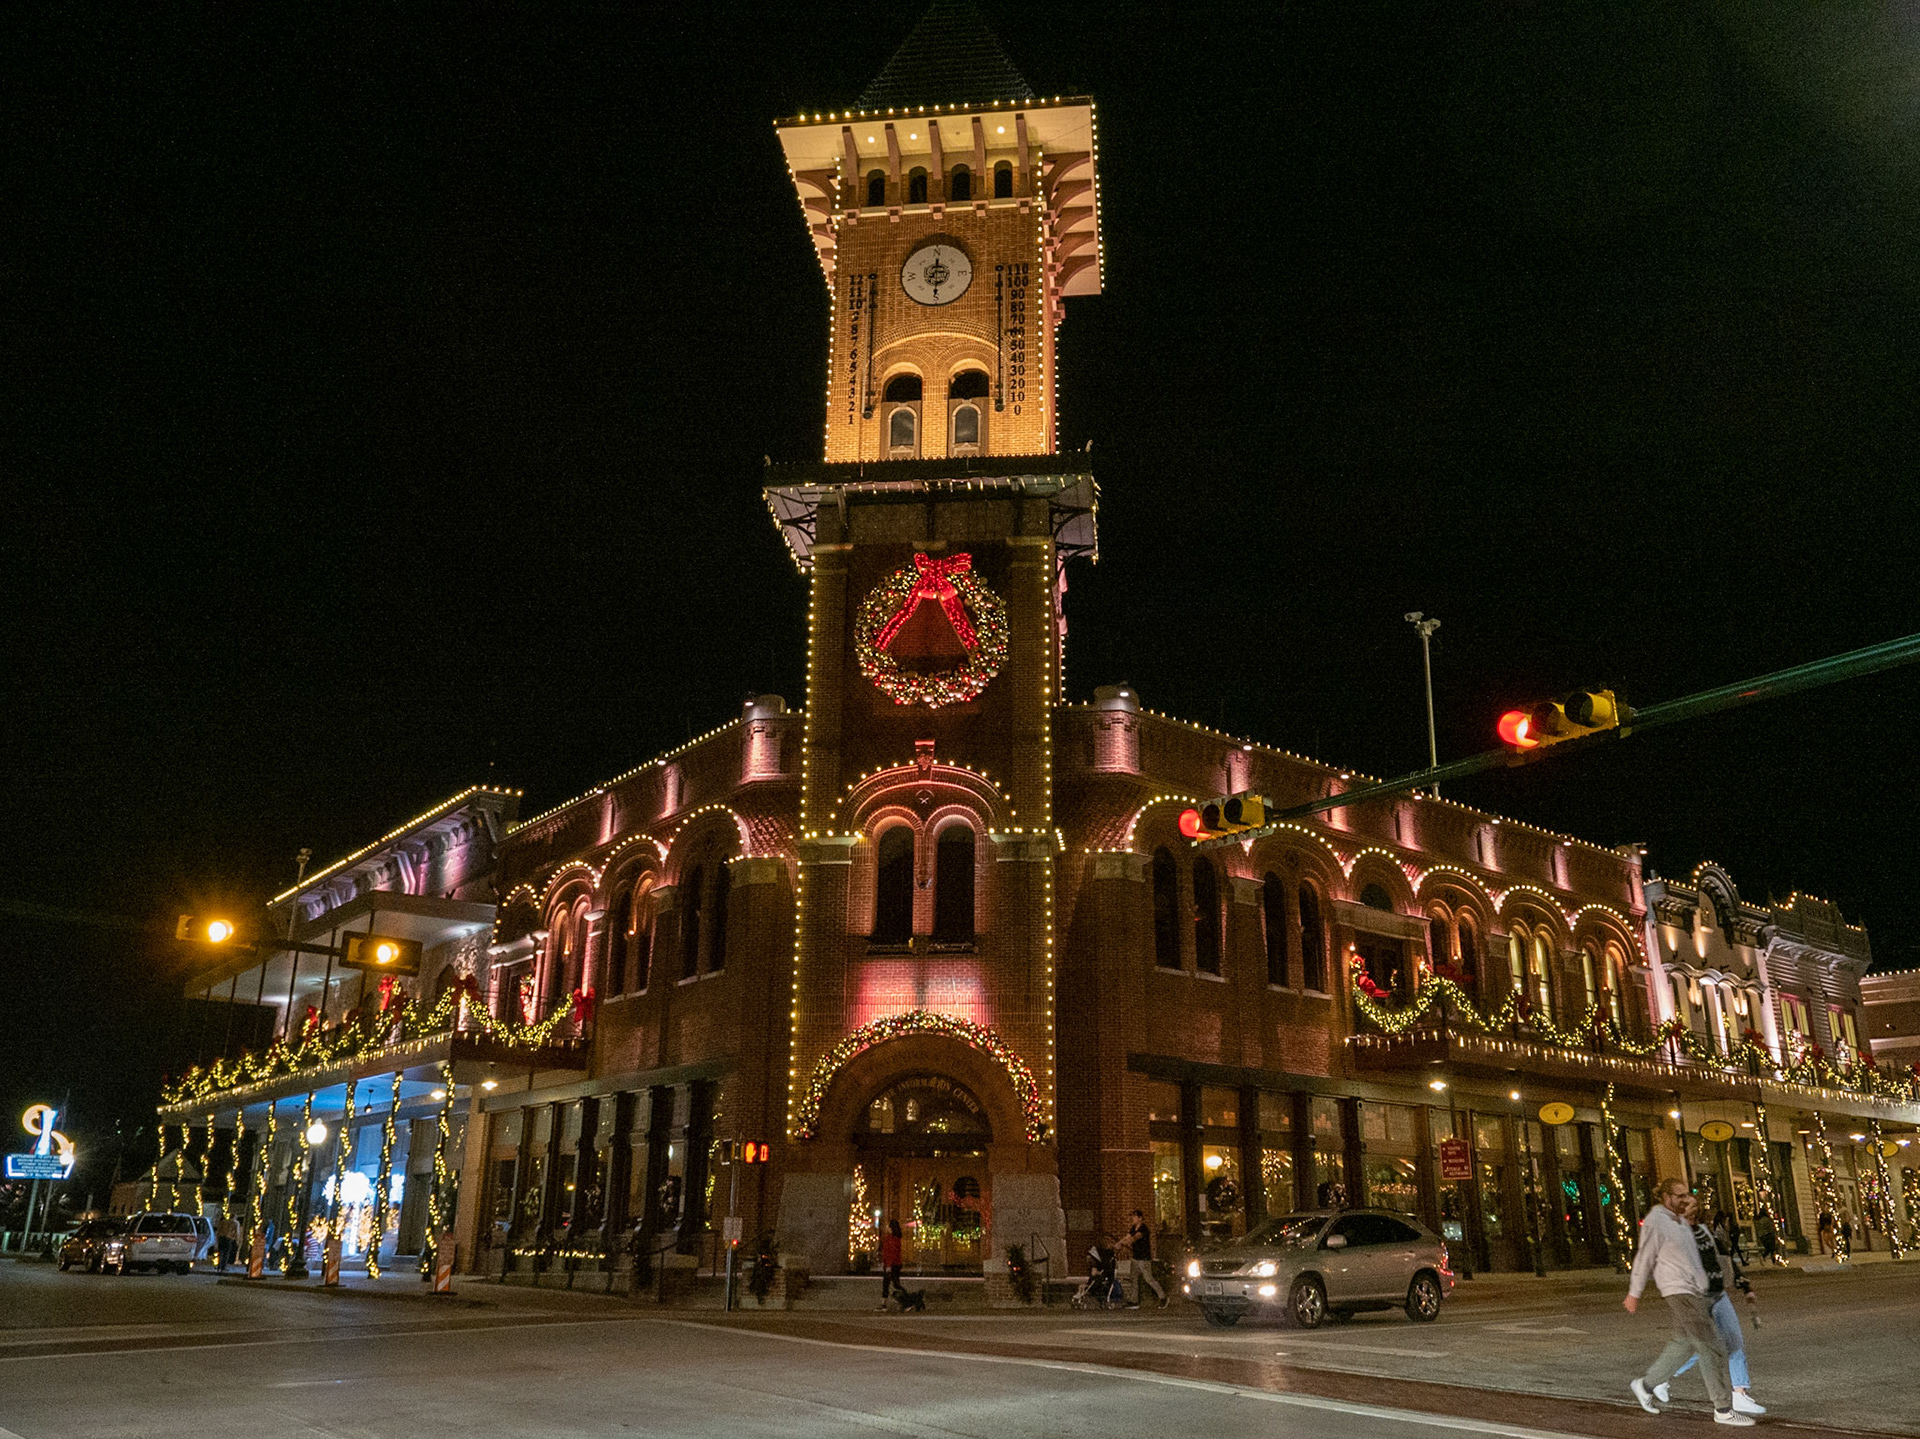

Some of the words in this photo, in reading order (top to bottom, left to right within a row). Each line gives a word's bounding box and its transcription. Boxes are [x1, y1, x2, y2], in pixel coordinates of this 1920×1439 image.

[933, 248, 941, 256] N
[1007, 263, 1029, 275] 110
[849, 274, 863, 285] 12
[906, 271, 916, 282] W
[1007, 276, 1029, 288] 100
[849, 287, 862, 297] 11
[933, 293, 940, 301] S
[1011, 289, 1025, 300] 90
[849, 299, 863, 310] 10
[1011, 301, 1025, 312] 80
[1010, 313, 1025, 325] 70
[851, 324, 859, 335] 8
[851, 336, 858, 347] 7
[1010, 339, 1025, 351] 50
[850, 348, 858, 360] 6
[1010, 352, 1025, 363] 40
[849, 361, 857, 373] 5
[1010, 365, 1025, 376] 30
[849, 374, 856, 385] 4
[1010, 378, 1025, 389] 20
[848, 387, 855, 399] 3
[1010, 391, 1025, 402] 10
[848, 401, 855, 411] 2
[1014, 404, 1021, 416] 0
[848, 414, 853, 425] 1
[953, 1087, 980, 1114] CENTER
